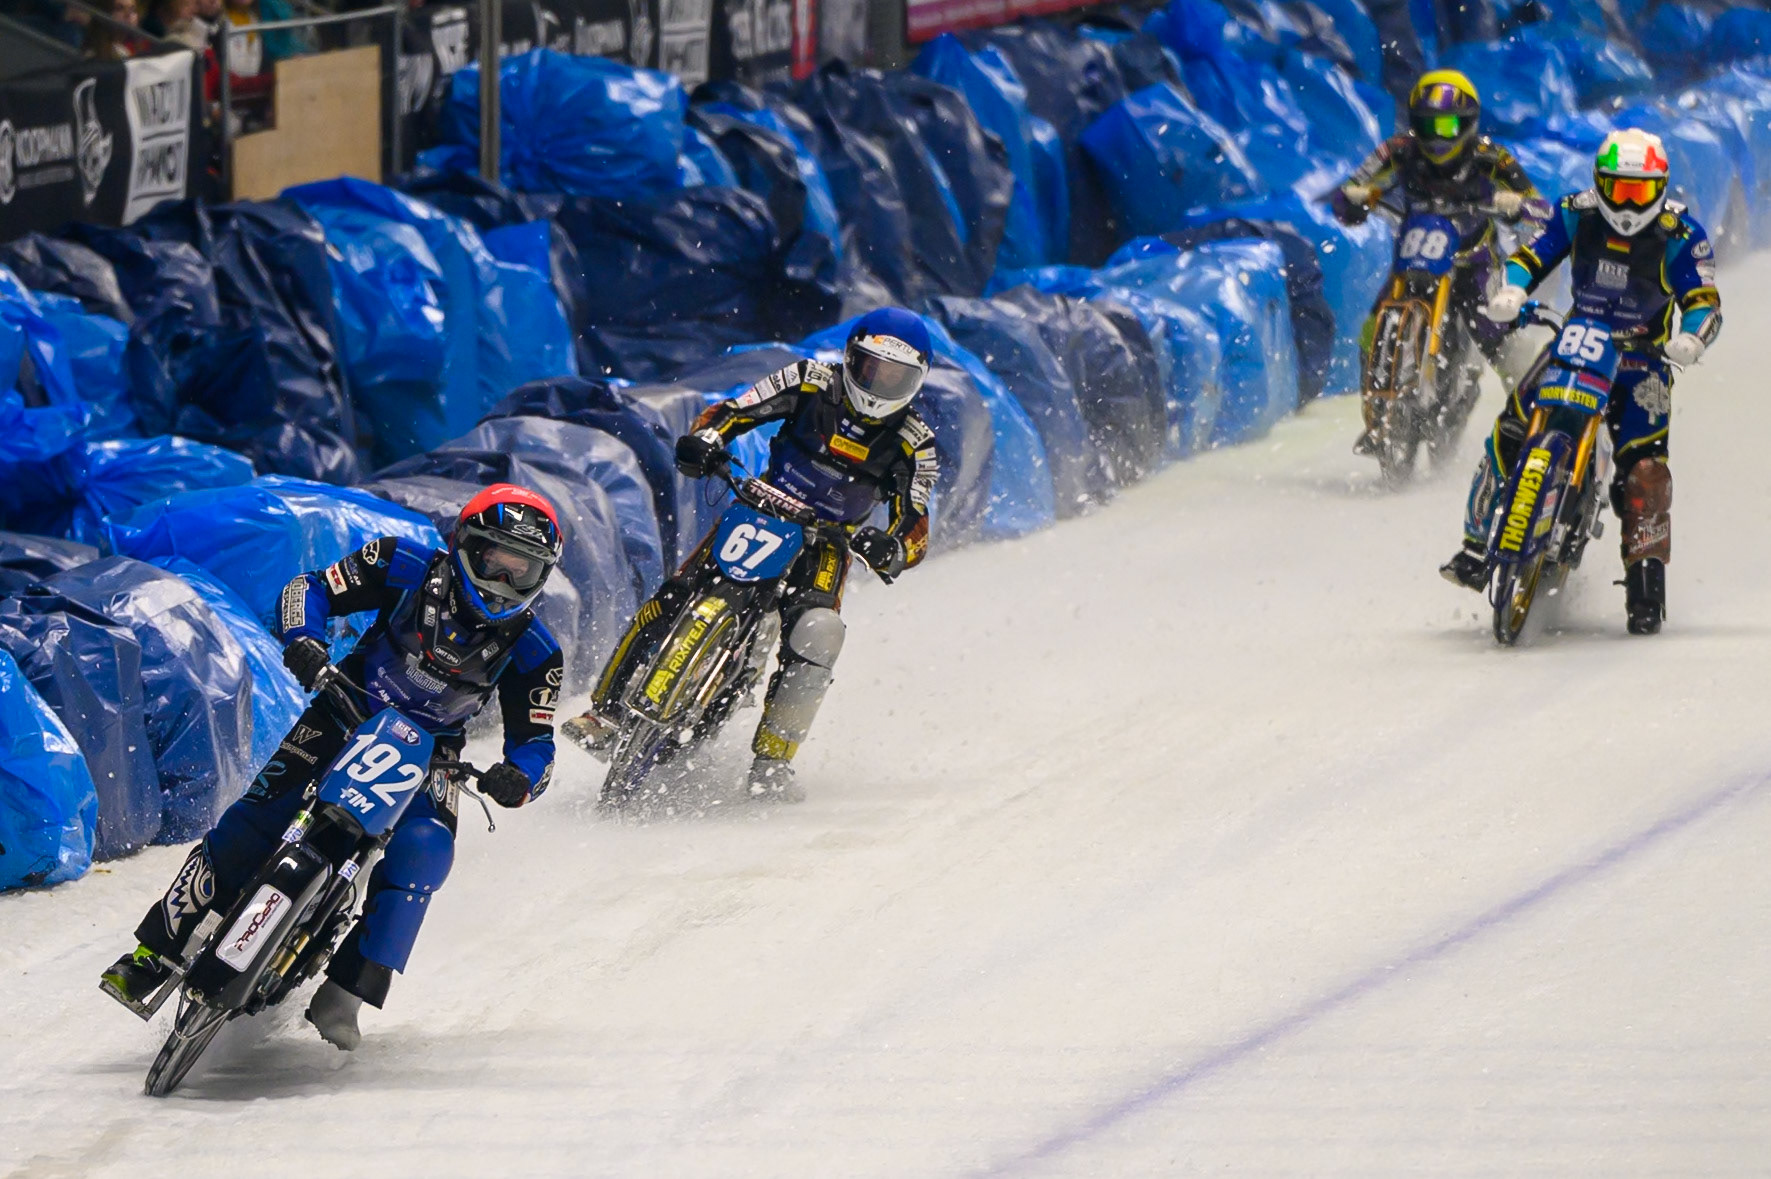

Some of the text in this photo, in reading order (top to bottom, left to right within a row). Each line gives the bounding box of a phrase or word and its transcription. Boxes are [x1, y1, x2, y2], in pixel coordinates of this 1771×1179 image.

[1400, 227, 1448, 260] 88
[1557, 324, 1612, 363] 85
[1500, 447, 1552, 552] THORWESTEN
[719, 523, 784, 570] 67
[333, 733, 424, 807] 192
[340, 787, 376, 814] FIM
